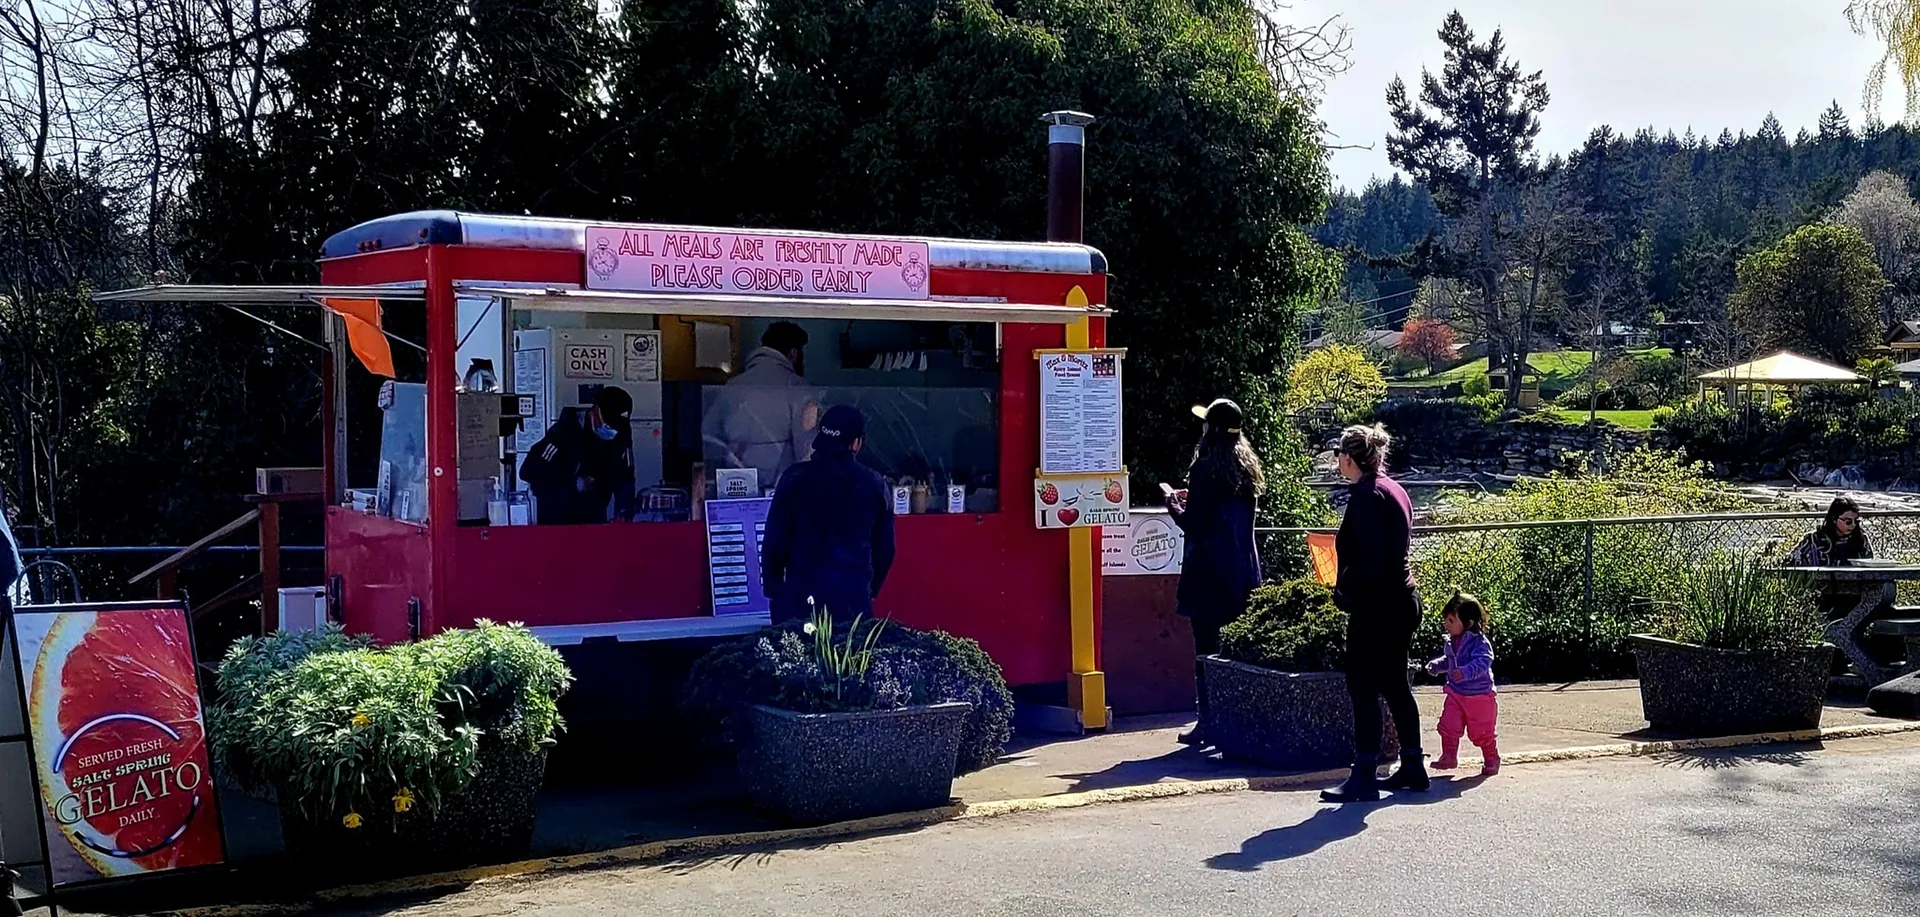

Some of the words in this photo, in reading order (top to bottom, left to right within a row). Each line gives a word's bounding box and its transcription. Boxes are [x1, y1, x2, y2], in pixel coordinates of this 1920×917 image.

[619, 231, 653, 256] ALL
[662, 234, 722, 259] MEALS
[730, 236, 763, 261] ARE
[775, 241, 847, 264] FRESHLY
[853, 242, 902, 267] MADE
[651, 262, 722, 289] PLEASE
[732, 267, 803, 292] ORDER
[812, 267, 873, 292] EARLY
[571, 348, 606, 359] CASH
[571, 360, 607, 370] ONLY
[1040, 508, 1048, 527] I
[1083, 512, 1126, 524] GELATO
[1131, 537, 1176, 556] GELATO
[78, 749, 123, 769] SERVED
[126, 738, 163, 757] FRESH
[72, 769, 112, 788] SALT
[115, 753, 171, 776] SPRING
[55, 761, 201, 825] GELATO
[119, 807, 155, 827] DAILY
